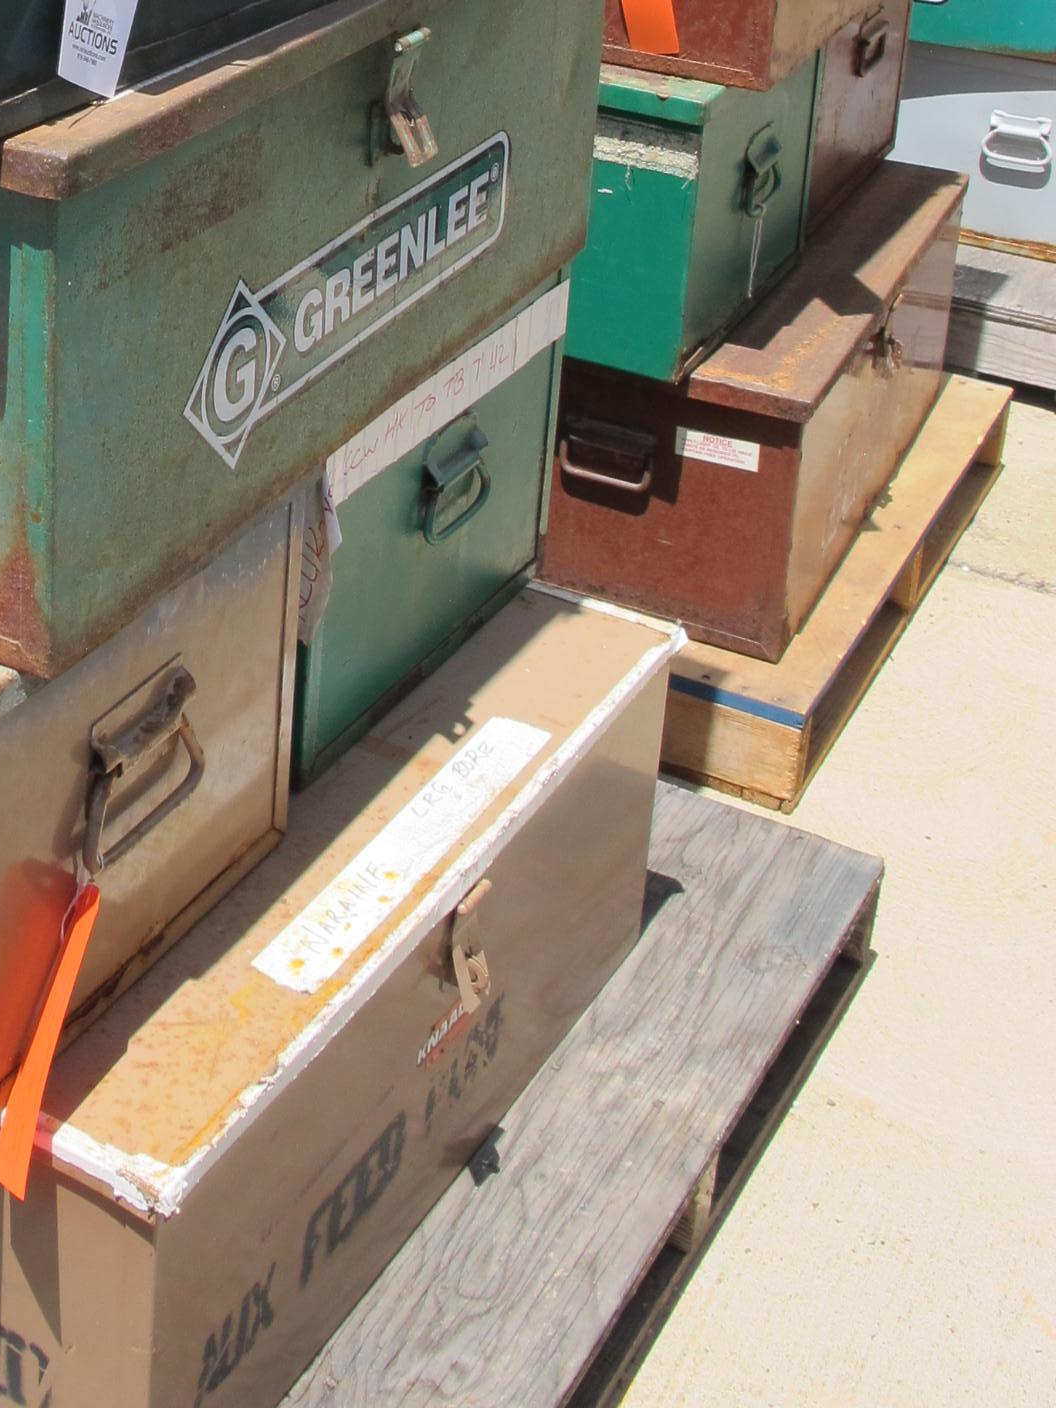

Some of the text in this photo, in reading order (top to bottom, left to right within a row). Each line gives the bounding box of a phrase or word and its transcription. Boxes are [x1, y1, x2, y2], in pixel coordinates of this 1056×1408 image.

[68, 21, 119, 55] AUCTIONS
[212, 170, 490, 423] G GREENLEE
[703, 436, 732, 448] NOTICE
